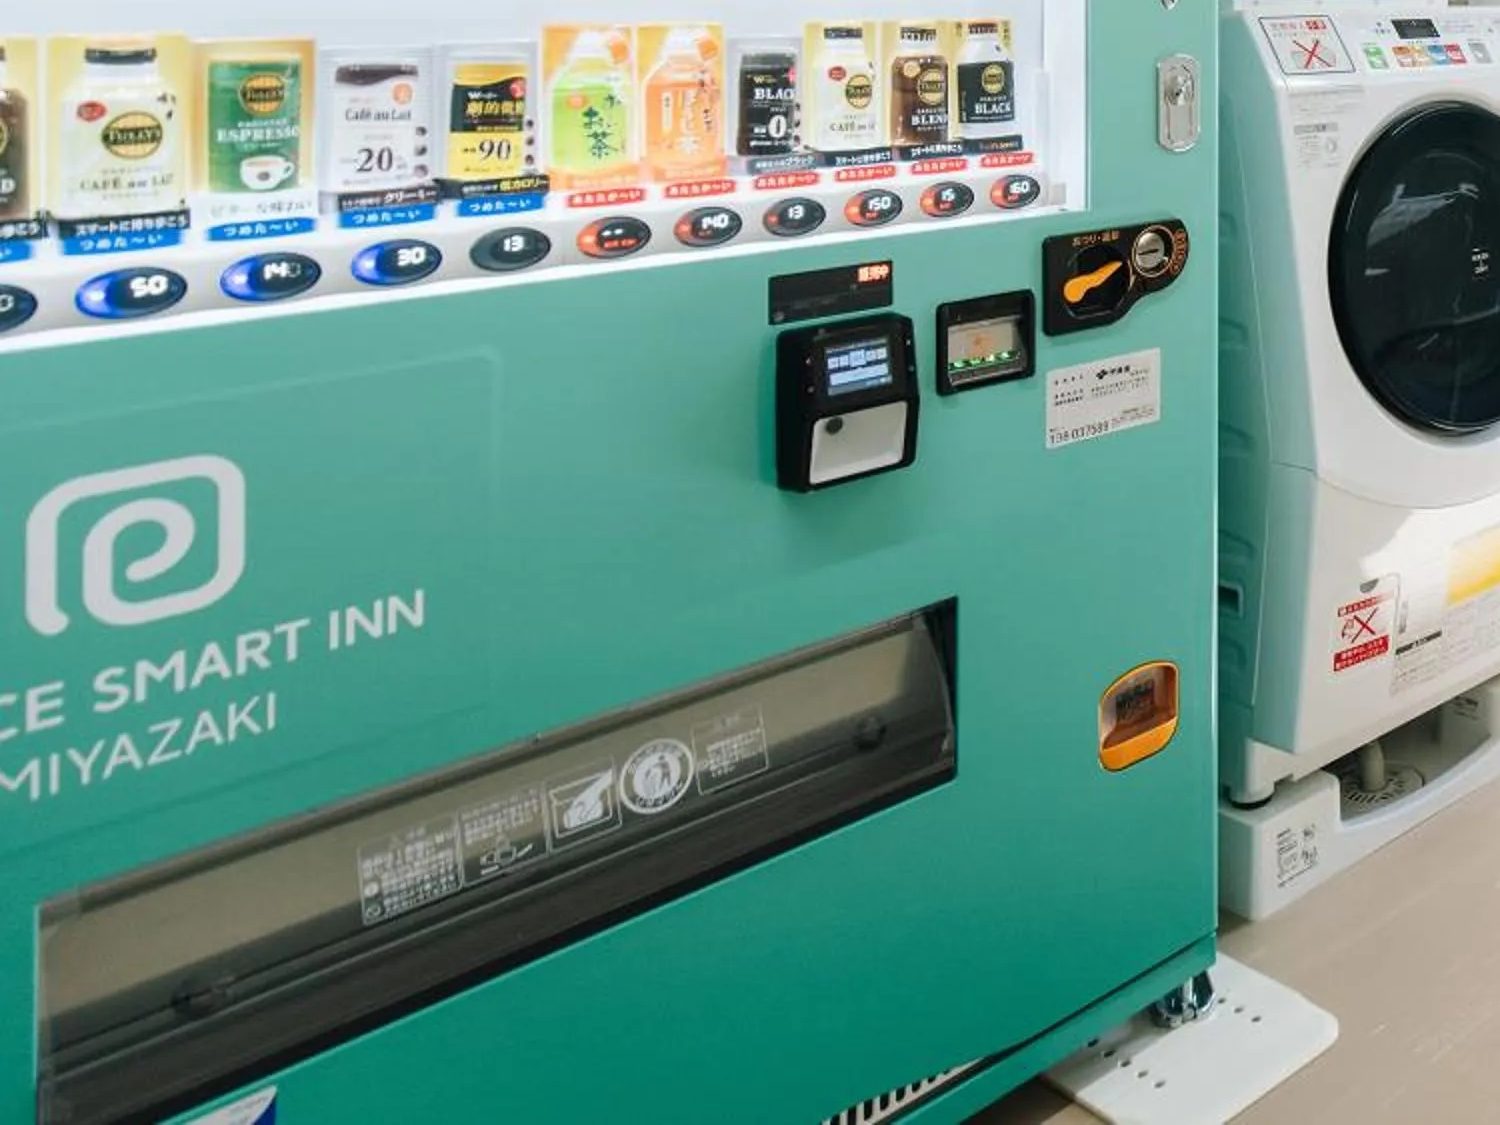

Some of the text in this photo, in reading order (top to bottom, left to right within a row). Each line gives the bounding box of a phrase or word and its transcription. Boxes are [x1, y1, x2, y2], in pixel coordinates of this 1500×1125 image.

[356, 146, 393, 173] 20
[478, 138, 511, 161] 90
[93, 618, 311, 713] SMART
[328, 588, 425, 651] INN
[0, 692, 278, 803] MIYAZAKI
